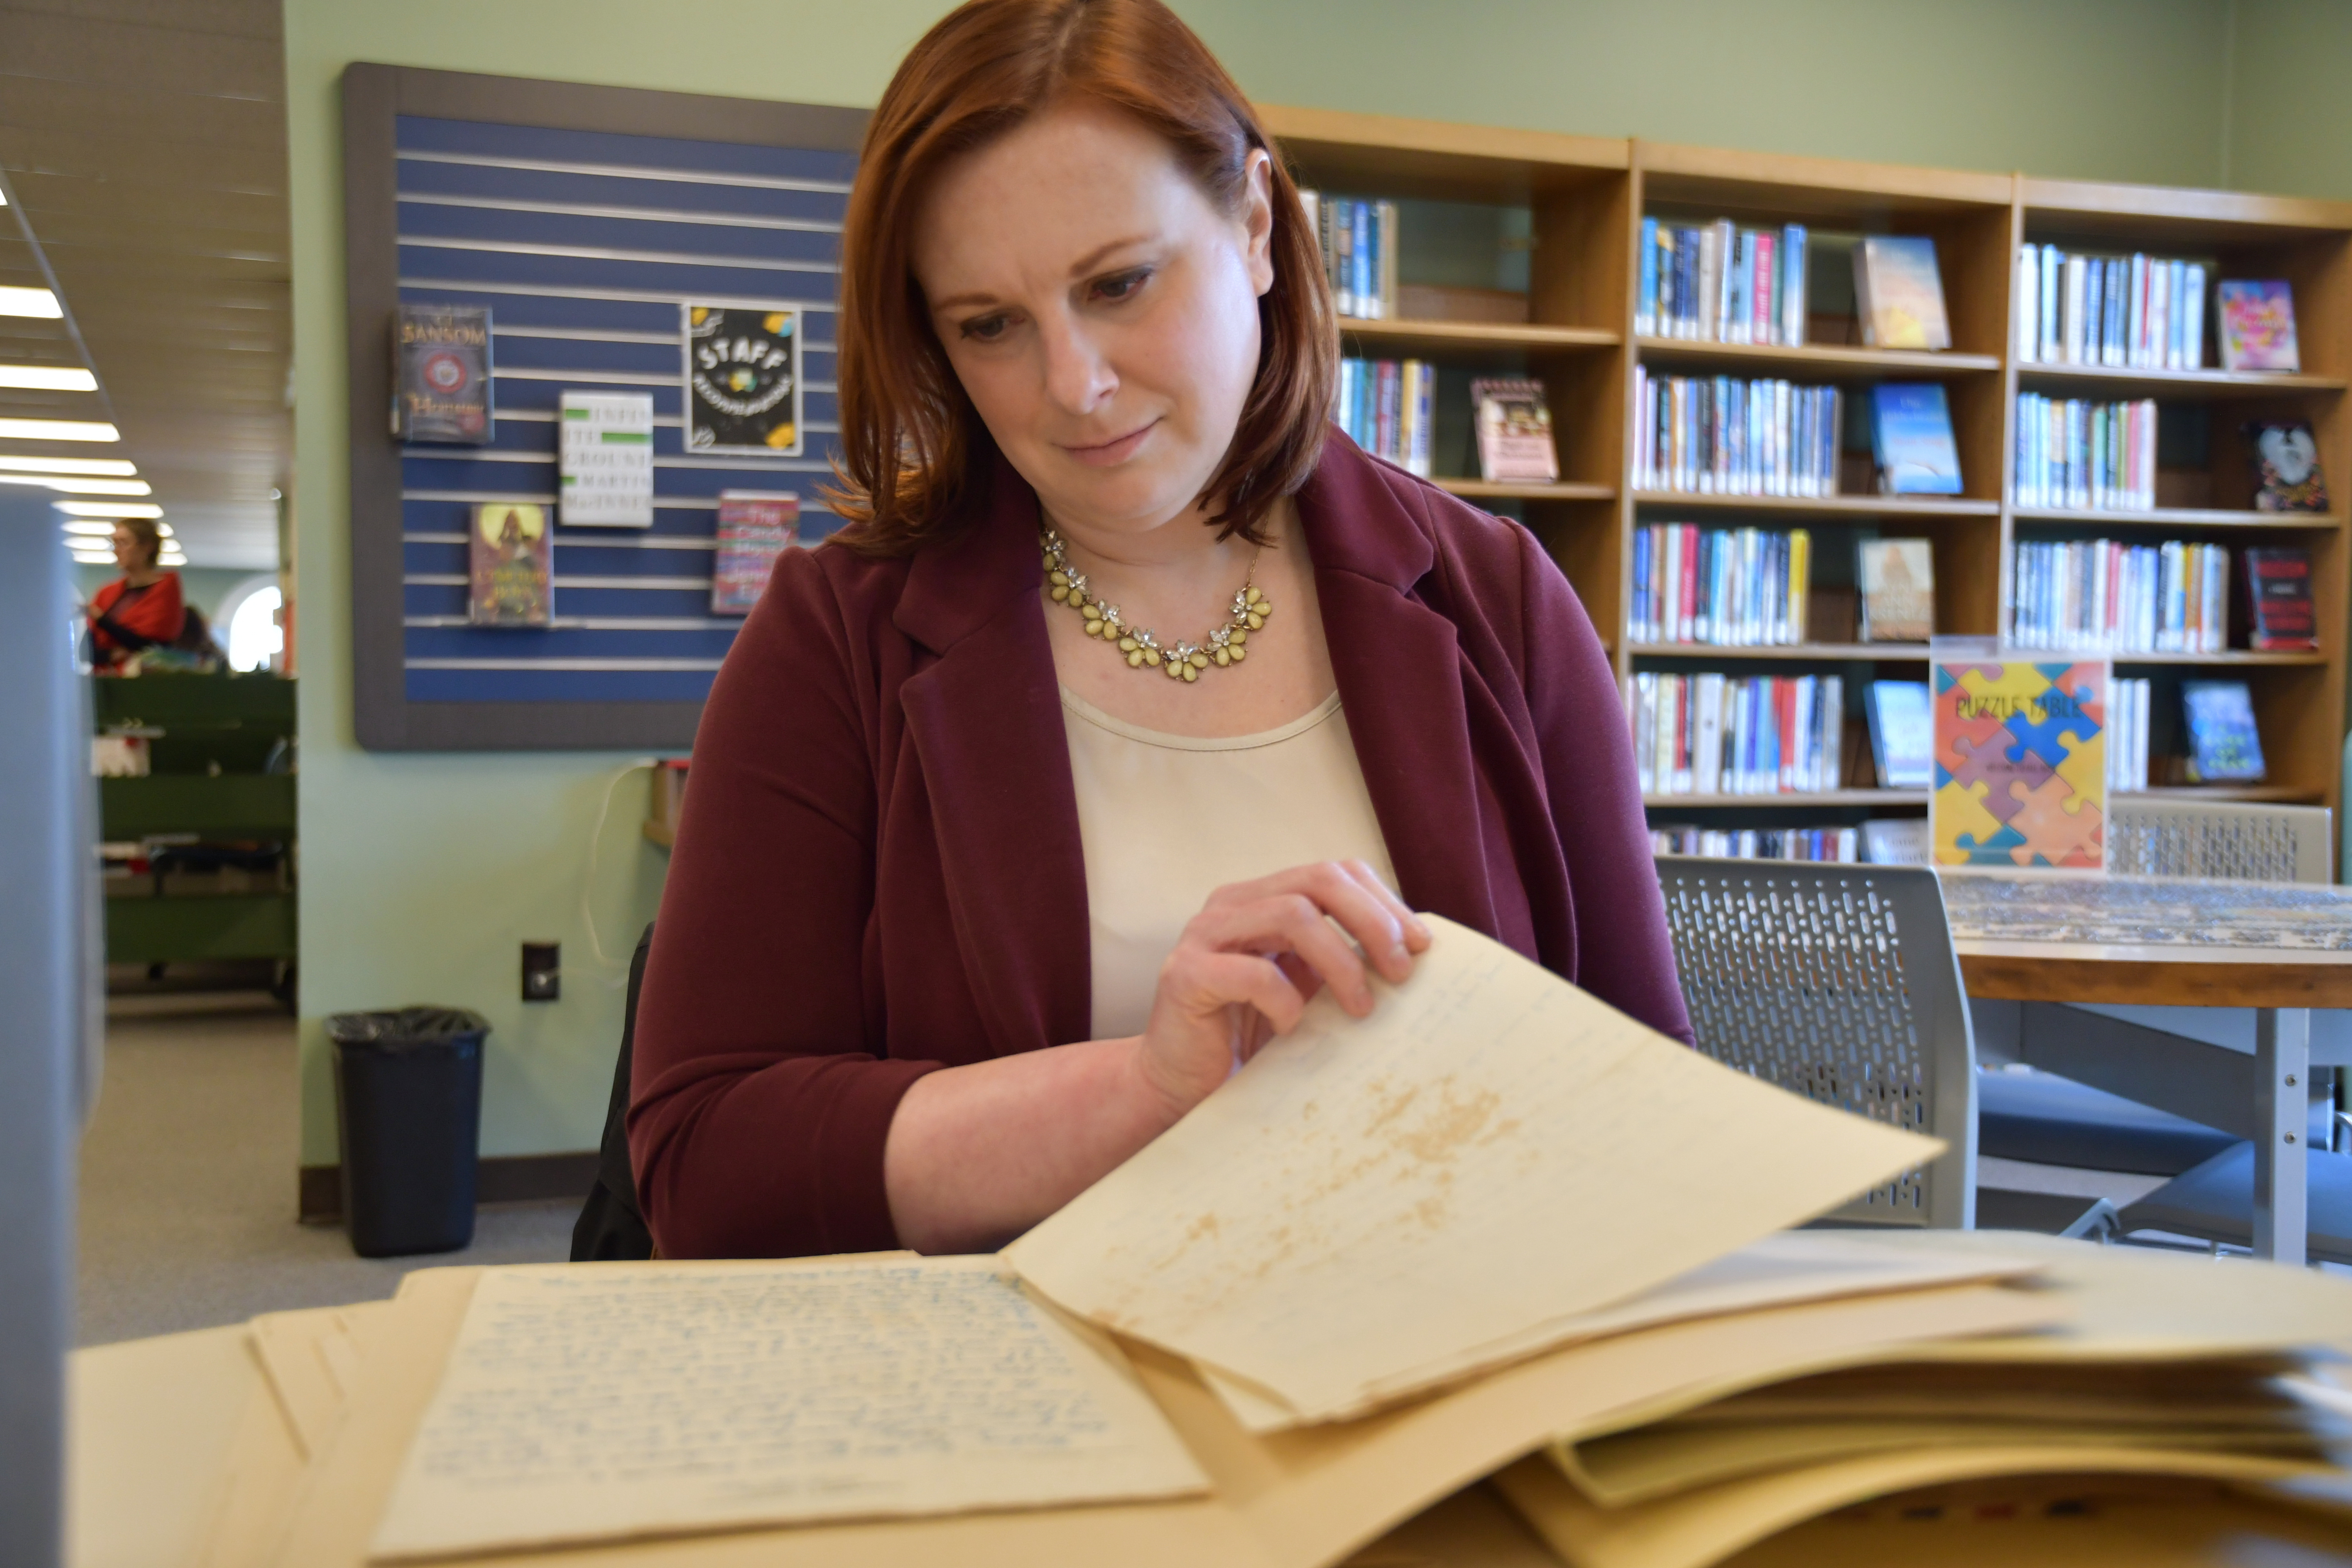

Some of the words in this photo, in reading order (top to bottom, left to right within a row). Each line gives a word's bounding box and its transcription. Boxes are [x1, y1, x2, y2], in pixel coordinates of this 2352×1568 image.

[400, 323, 486, 345] SANSOM
[697, 336, 787, 370] STAFF
[1956, 696, 2020, 718] PUZZLE
[2027, 696, 2081, 718] TABLE
